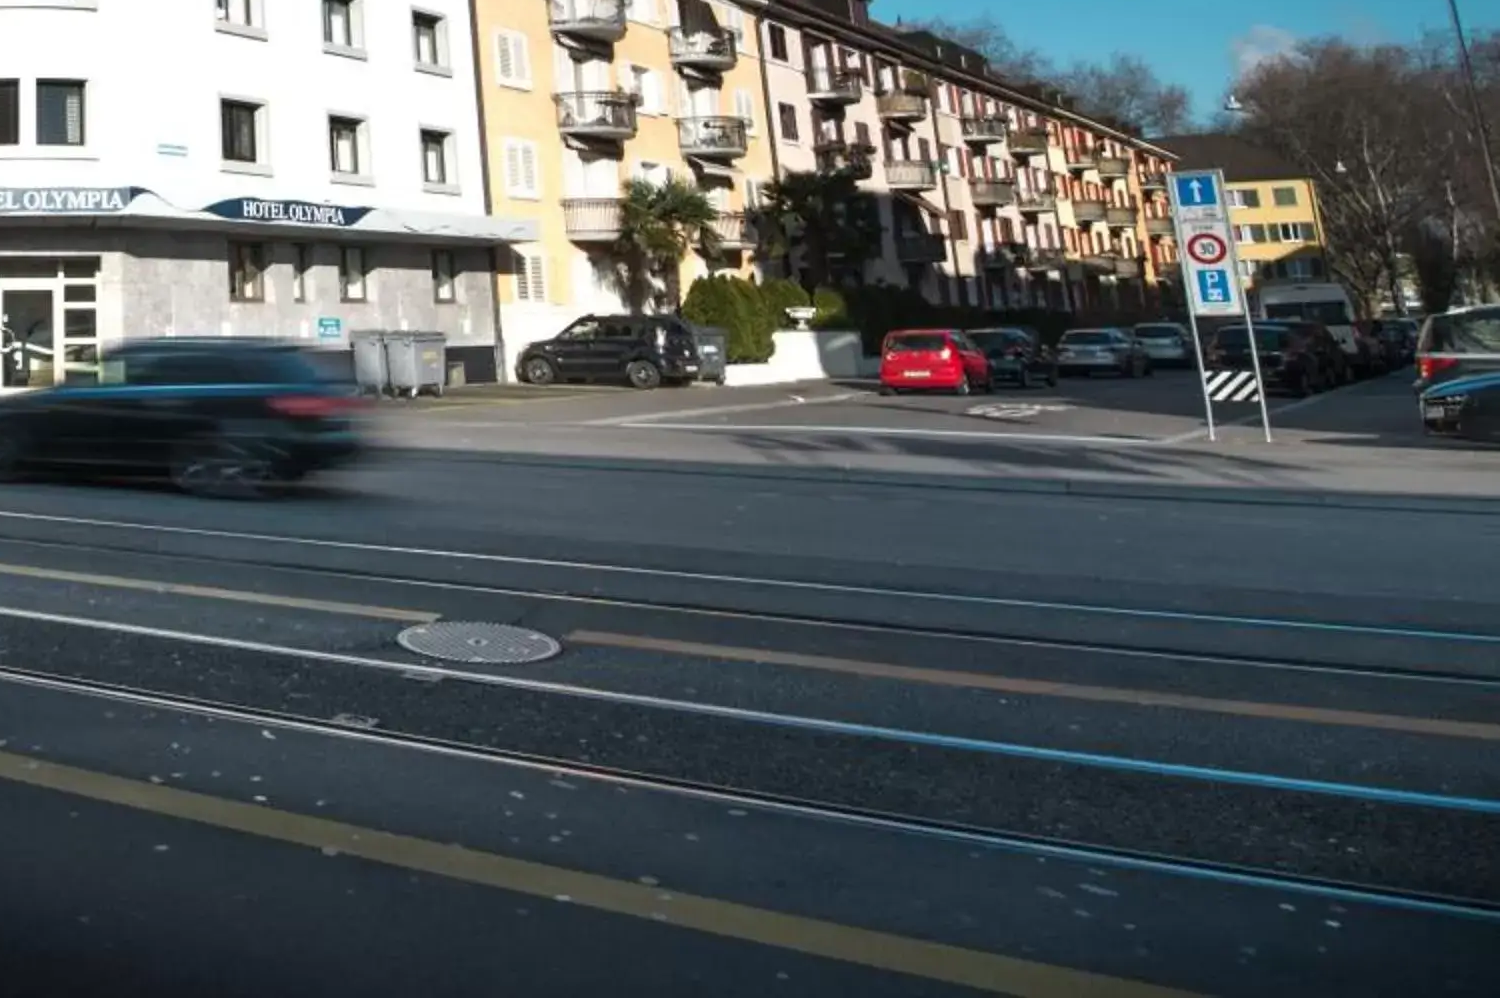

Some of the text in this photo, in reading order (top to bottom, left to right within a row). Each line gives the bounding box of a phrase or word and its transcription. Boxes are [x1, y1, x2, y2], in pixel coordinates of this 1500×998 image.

[23, 190, 125, 210] OLYMPIA
[243, 200, 345, 225] HOTEL OLYMPIA
[1200, 241, 1216, 255] 30
